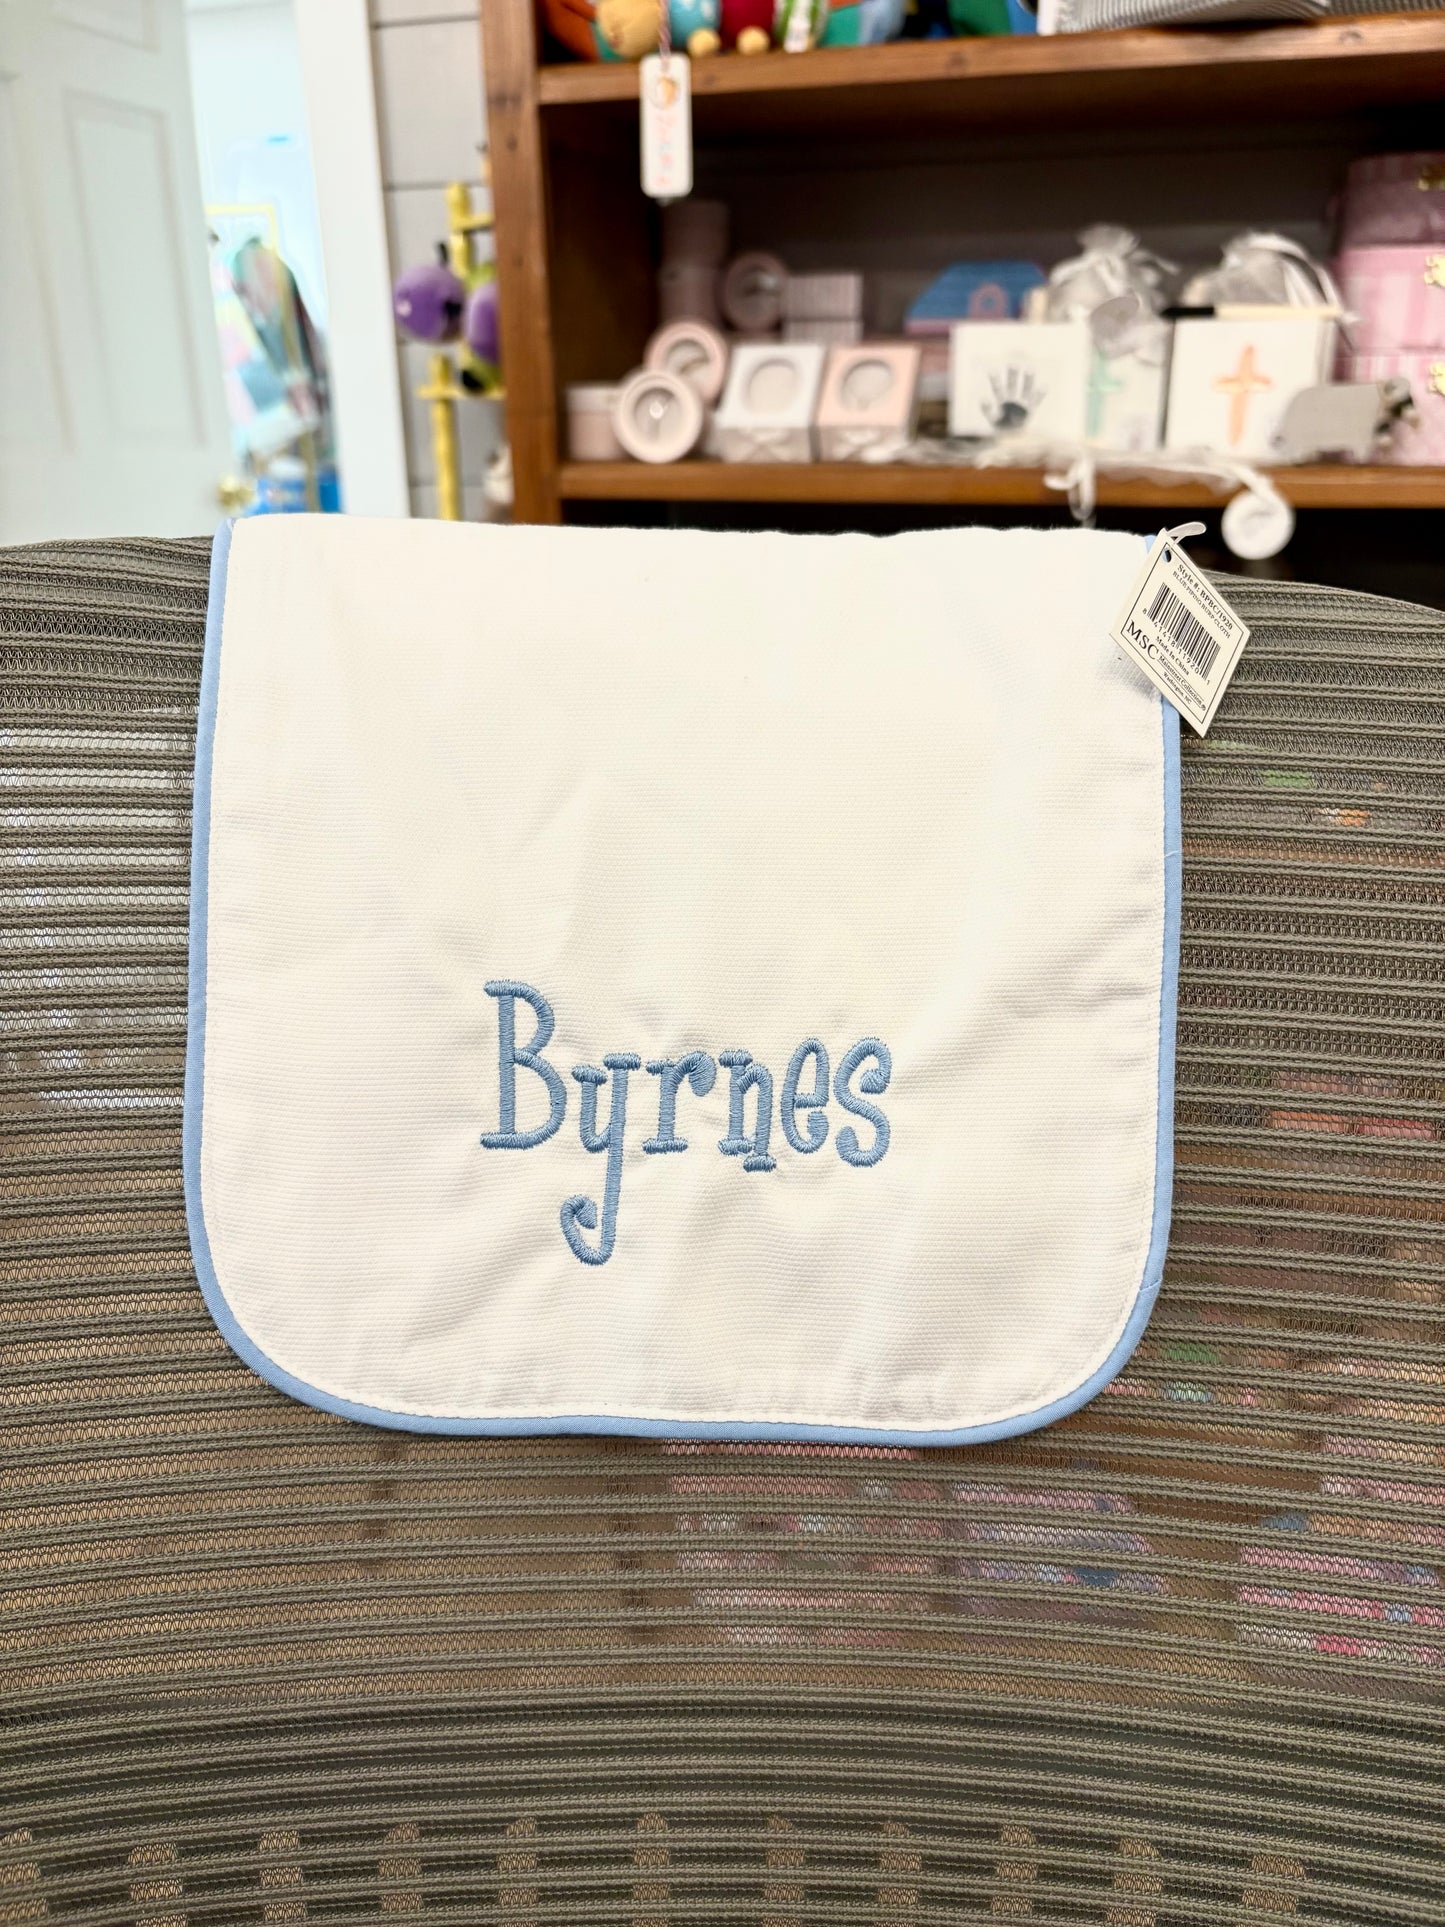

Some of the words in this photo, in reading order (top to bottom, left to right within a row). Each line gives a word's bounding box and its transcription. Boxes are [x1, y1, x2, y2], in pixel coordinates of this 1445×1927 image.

[1172, 570, 1187, 588] BLUE
[1185, 585, 1202, 605] PIPING
[1200, 603, 1214, 619] BURP
[1213, 617, 1231, 639] CLOTH
[1177, 563, 1194, 584] Style
[1199, 589, 1233, 630] BPBC/1920
[1126, 619, 1160, 659] MSC
[1155, 635, 1170, 653] Made
[1168, 651, 1175, 660] In
[1174, 657, 1189, 675] China
[1158, 655, 1181, 681] Mainstreet
[1184, 695, 1192, 704] NC
[480, 980, 893, 1266] Byrnes
